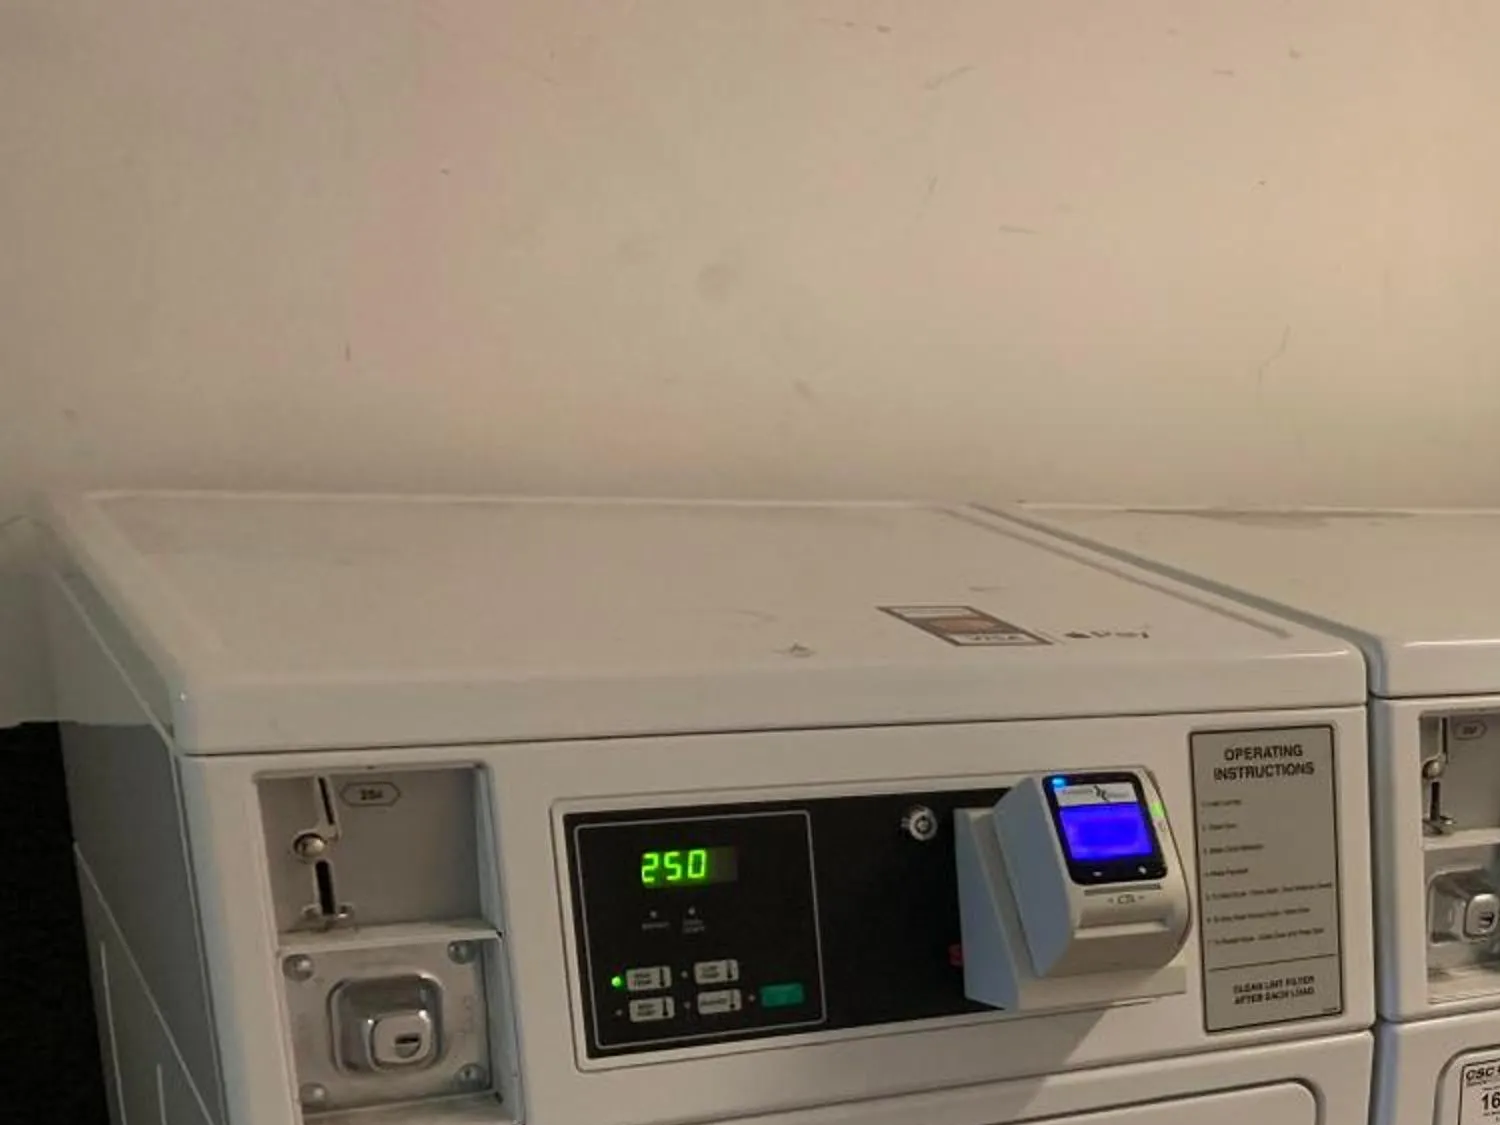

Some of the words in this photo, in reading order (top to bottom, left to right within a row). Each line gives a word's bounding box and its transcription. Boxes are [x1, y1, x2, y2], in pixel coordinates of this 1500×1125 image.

[1223, 744, 1304, 762] OPERATING
[1213, 761, 1316, 781] INSTRUCTIONS
[641, 849, 707, 883] 250
[1465, 1066, 1495, 1081] CSC
